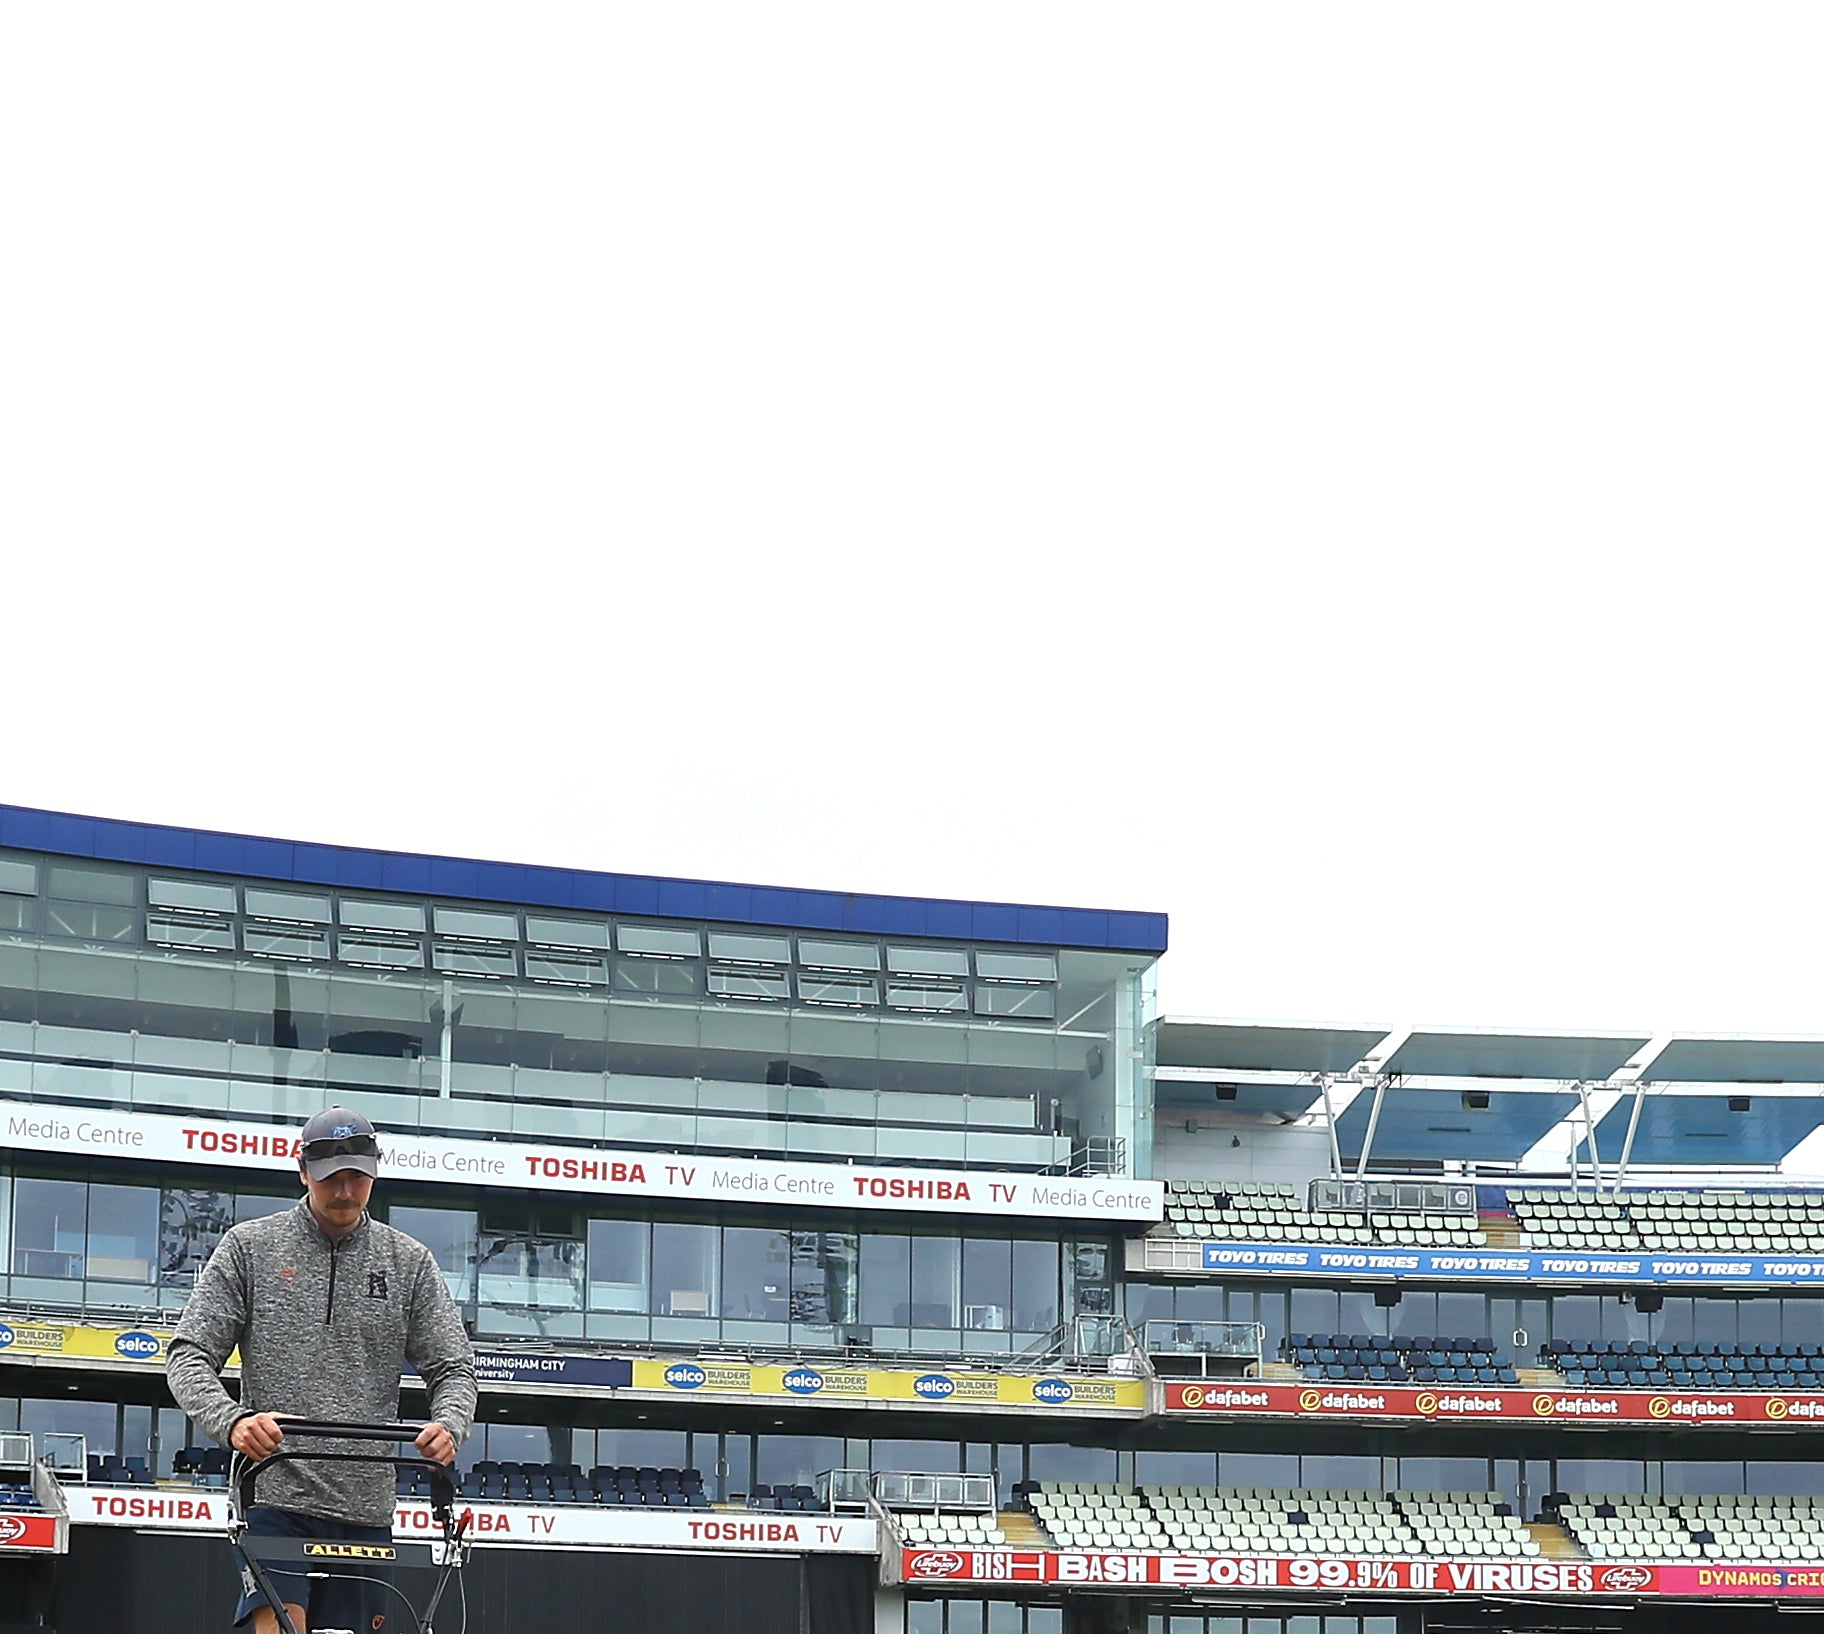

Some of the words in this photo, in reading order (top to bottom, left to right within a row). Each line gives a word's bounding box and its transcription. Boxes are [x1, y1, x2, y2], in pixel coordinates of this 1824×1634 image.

[9, 1117, 69, 1140] Media
[77, 1123, 143, 1146] Centre
[378, 1148, 437, 1170] Media
[441, 1151, 505, 1174] Centre
[526, 1157, 645, 1183] TOSHIBA
[665, 1166, 695, 1185] TV
[713, 1171, 768, 1190] Media
[775, 1174, 834, 1194] Centre
[854, 1178, 970, 1200] TOSHIBA
[989, 1184, 1016, 1202] TV
[1033, 1187, 1086, 1206] Media
[1093, 1190, 1151, 1209] Centre
[1209, 1251, 1256, 1263] TOYO
[1258, 1252, 1308, 1264] TIRES
[1321, 1254, 1366, 1267] TOYO
[1368, 1256, 1419, 1268] TIRES
[1431, 1258, 1478, 1269] TOYO
[1479, 1259, 1530, 1270] TIRES
[1652, 1262, 1699, 1274] TOYO
[1701, 1263, 1752, 1274] TIRES
[1764, 1264, 1811, 1275] TOYO
[16, 1331, 63, 1341] BUILDERS
[118, 1338, 157, 1352] selco
[473, 1356, 540, 1371] IRMINGHAM
[542, 1360, 566, 1372] CITY
[475, 1368, 515, 1381] niversity
[667, 1369, 704, 1382] selco
[708, 1371, 750, 1380] BUILDERS
[785, 1374, 821, 1387] selco
[825, 1376, 867, 1385] BUILDERS
[917, 1380, 952, 1392] selco
[956, 1381, 998, 1390] BUILDERS
[1035, 1384, 1070, 1397] selco
[1074, 1385, 1116, 1394] BUILDERS
[1205, 1390, 1268, 1407] dafabet
[1322, 1393, 1384, 1410] dafabet
[1439, 1396, 1501, 1413] dafabet
[1672, 1400, 1734, 1417] dafabet
[92, 1497, 212, 1520] TOSHIBA
[527, 1516, 555, 1533] TV
[688, 1522, 799, 1541] TOSHIBA
[816, 1526, 842, 1543] TV
[311, 1544, 390, 1558] ALLETT
[913, 1556, 962, 1572] Lifebuoy
[973, 1553, 1044, 1579] BISH
[1059, 1555, 1146, 1581] BASH
[1160, 1557, 1277, 1586] BOSH
[1289, 1559, 1398, 1588] 99.9%
[1410, 1563, 1438, 1588] OF
[1448, 1564, 1592, 1591] VIRUSES
[1604, 1570, 1649, 1586] Lifebuoy
[1700, 1570, 1781, 1585] DYNAMOS
